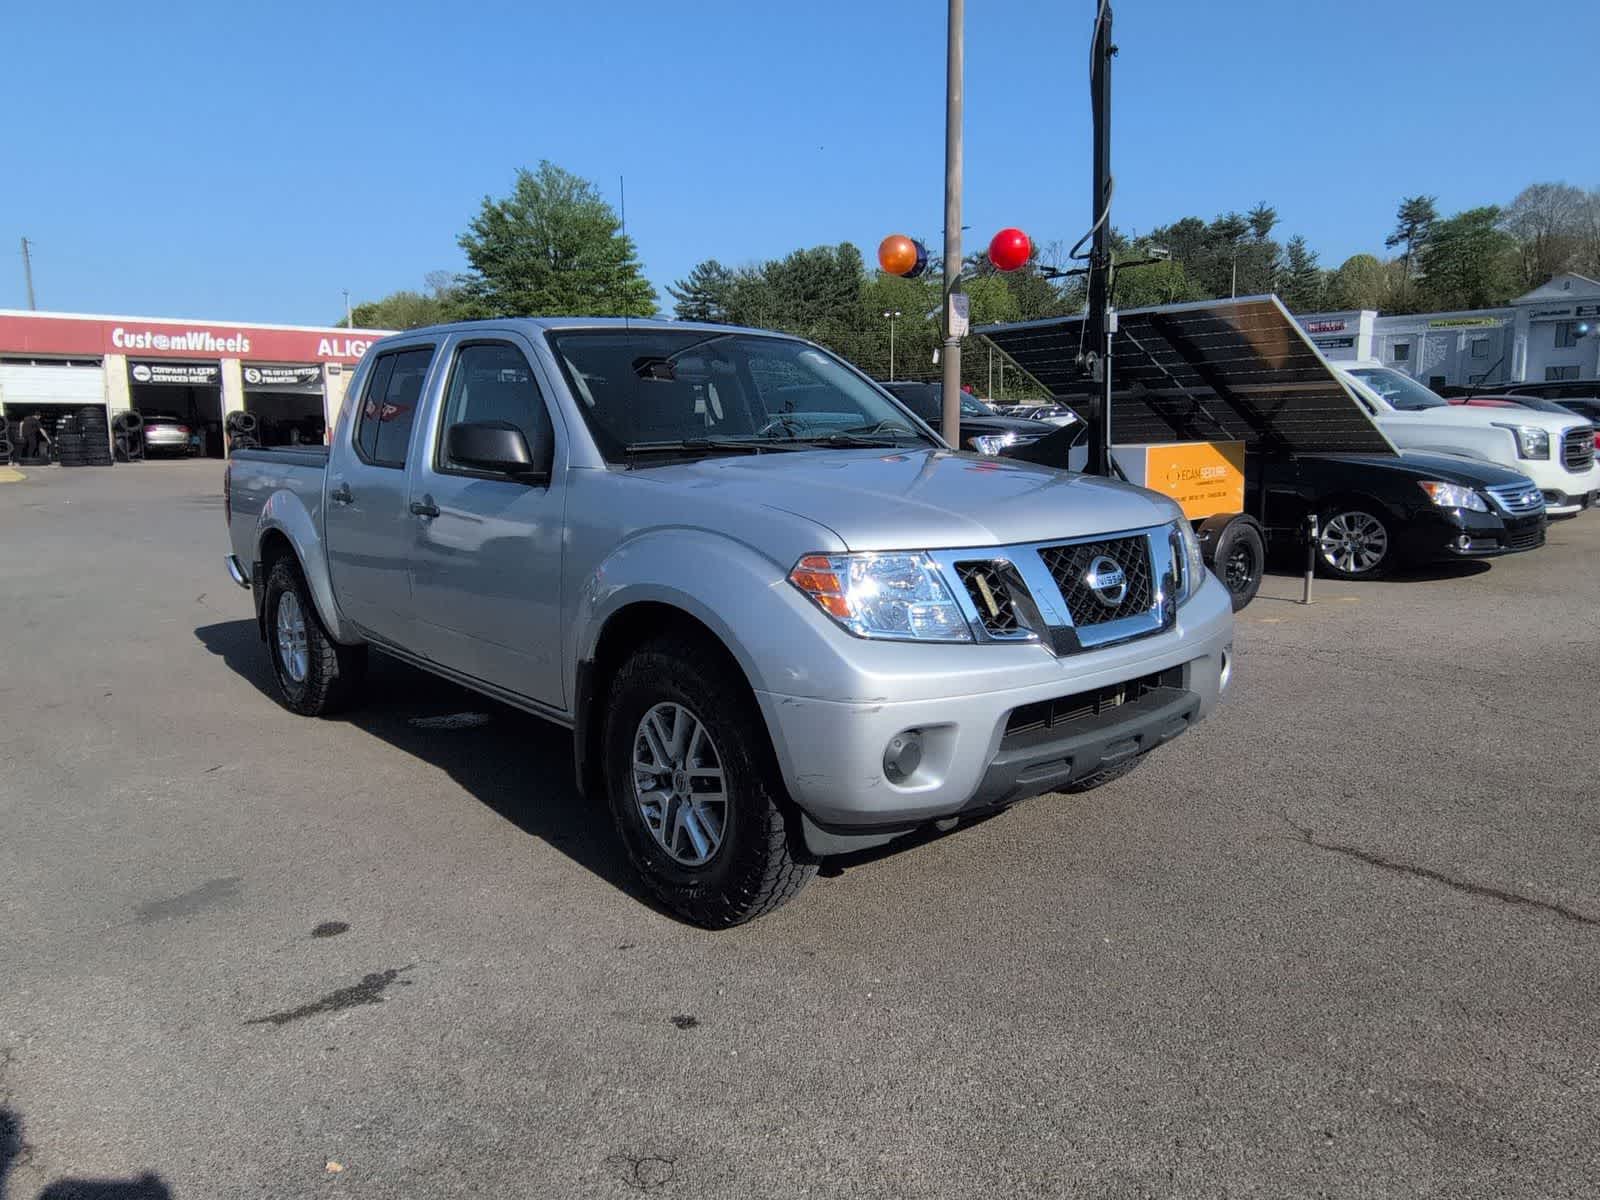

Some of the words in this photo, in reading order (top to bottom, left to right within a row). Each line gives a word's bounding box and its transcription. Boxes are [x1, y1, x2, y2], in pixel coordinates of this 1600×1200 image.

[112, 327, 250, 353] CustomWheels
[318, 339, 373, 358] ALIG
[151, 366, 187, 375] COMPANY
[188, 367, 218, 376] FLEETS
[151, 374, 188, 383] SERVICED
[1096, 573, 1124, 587] NISSAN
